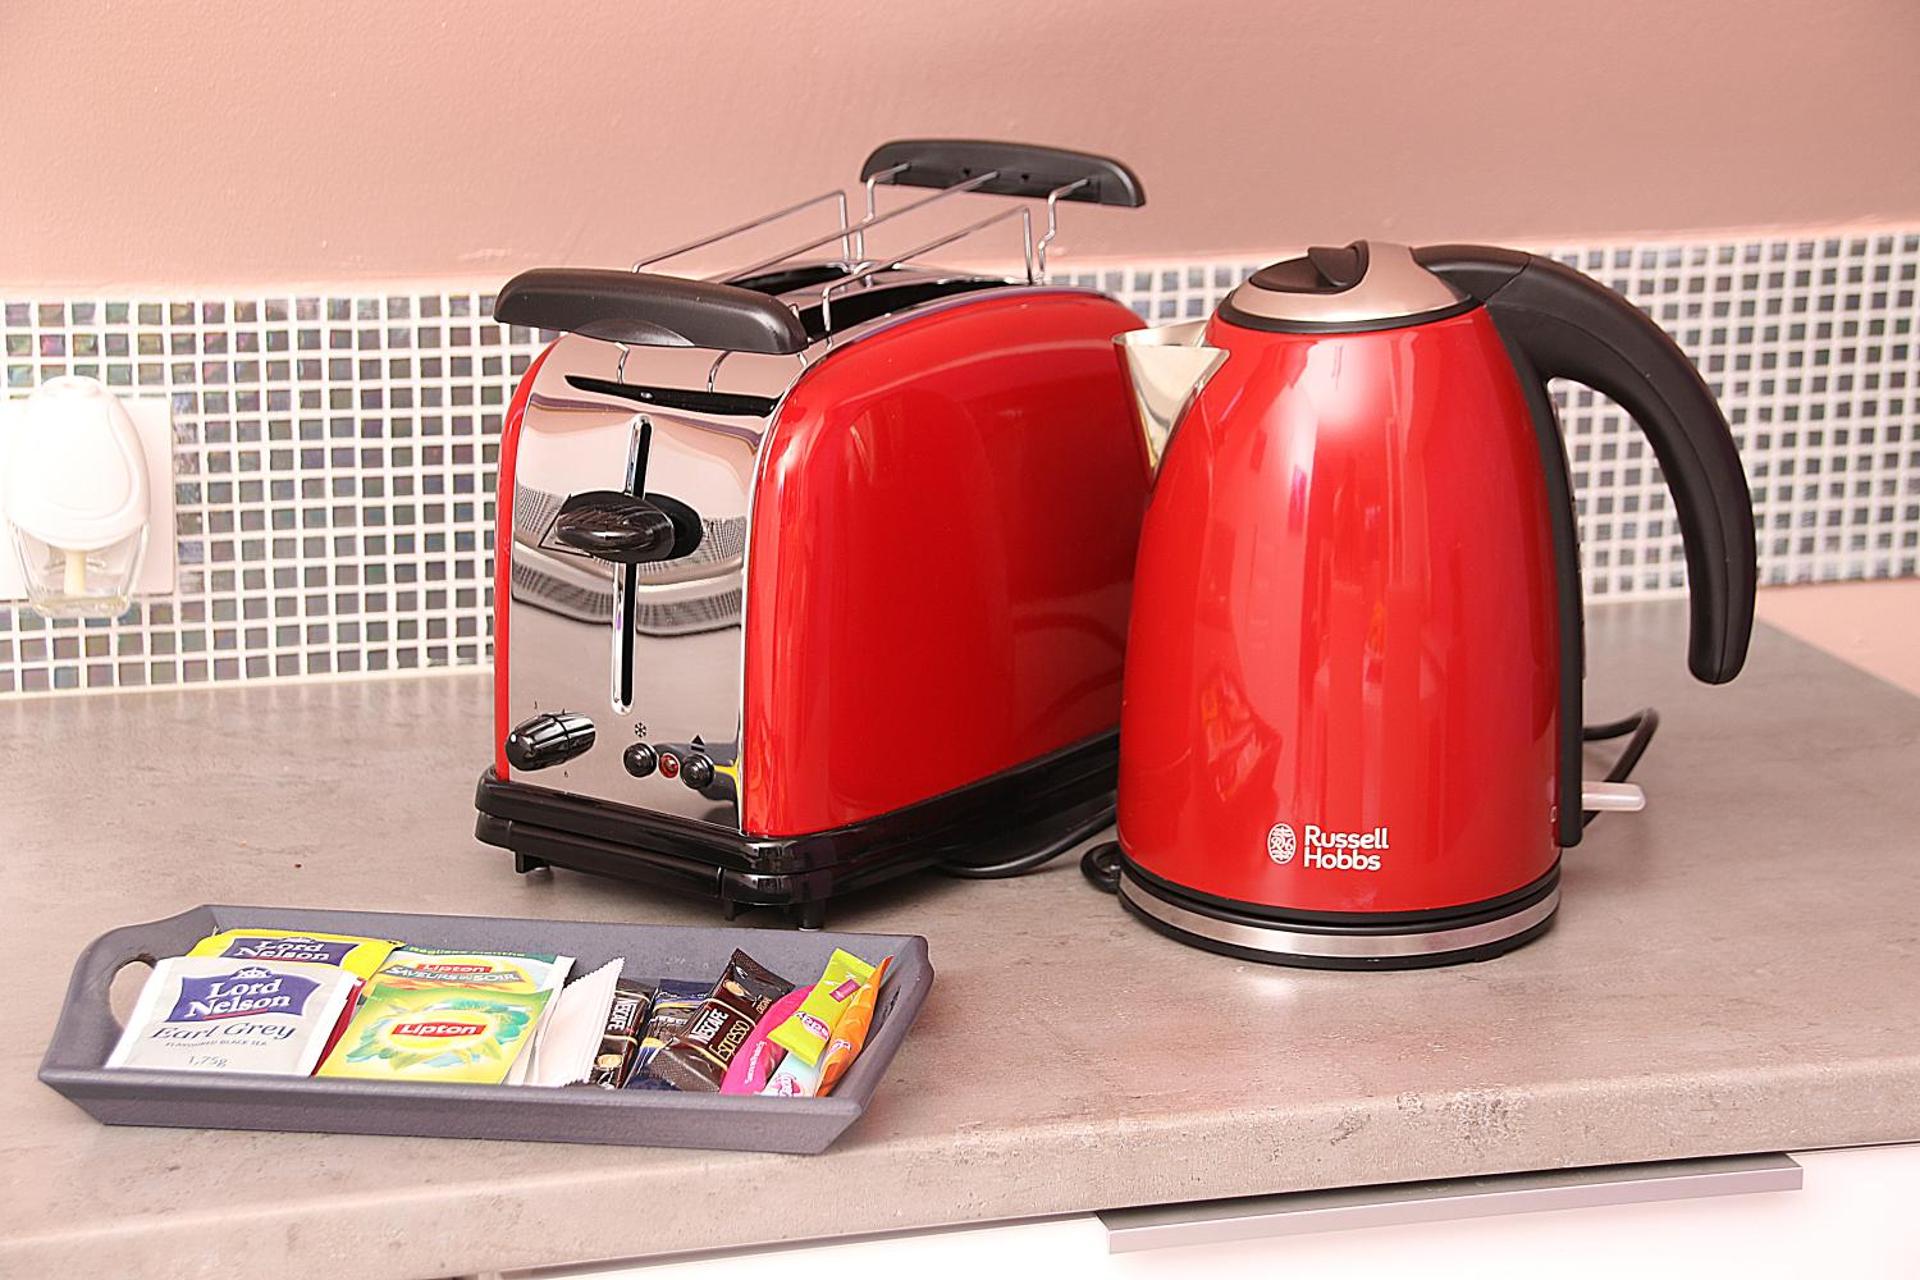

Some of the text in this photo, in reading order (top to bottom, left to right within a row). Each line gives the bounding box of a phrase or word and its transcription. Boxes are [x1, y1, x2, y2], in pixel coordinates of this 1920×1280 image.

[1305, 824, 1390, 849] Russell
[1303, 847, 1382, 871] Hobbs
[233, 946, 330, 960] Nelson
[254, 941, 325, 952] Lord
[422, 964, 486, 973] Lipton
[206, 978, 284, 1000] Lord
[184, 996, 293, 1018] Nelson
[150, 1022, 297, 1040] Earl Grey
[400, 1023, 477, 1036] Lipton
